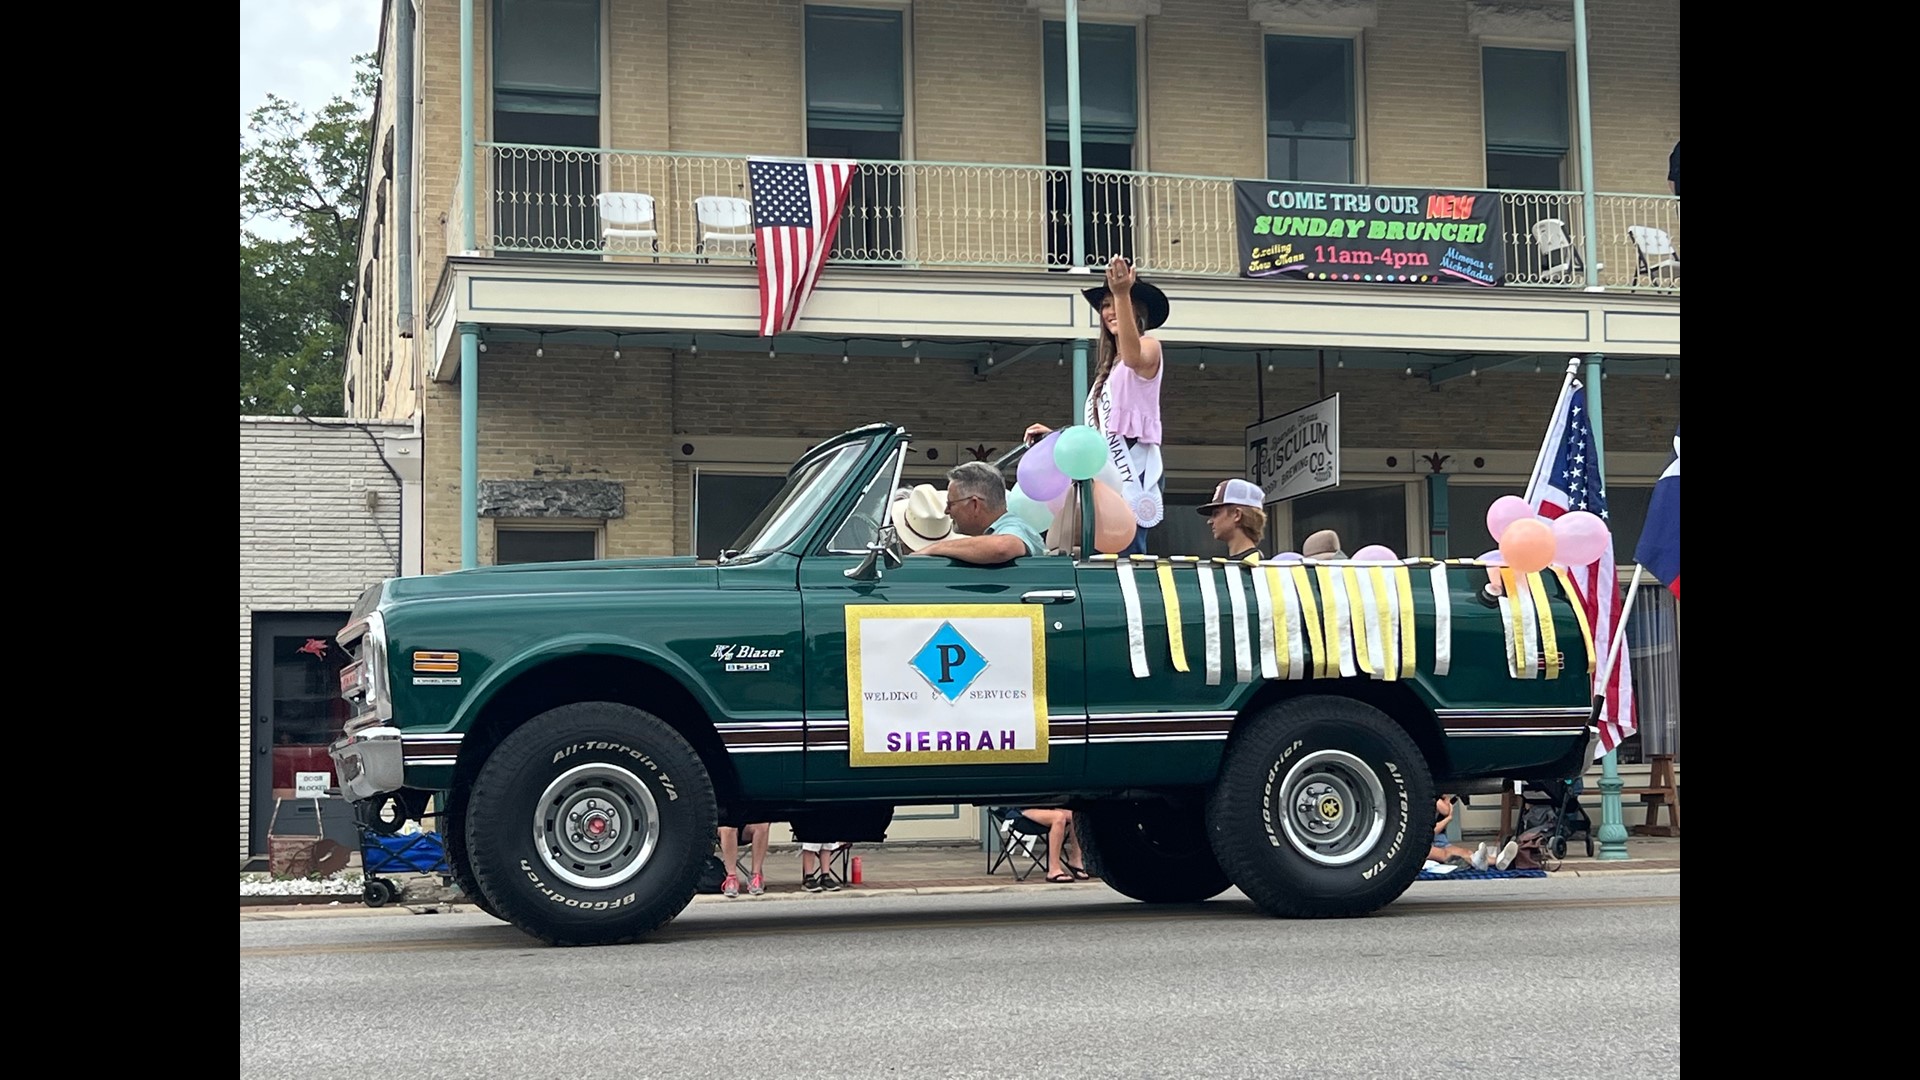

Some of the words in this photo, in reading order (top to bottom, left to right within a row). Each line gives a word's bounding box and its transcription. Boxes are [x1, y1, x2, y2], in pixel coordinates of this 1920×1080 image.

[1267, 190, 1327, 210] COME
[1330, 193, 1371, 213] TRY
[1375, 195, 1419, 215] OUR
[1426, 194, 1475, 220] NEW
[1253, 215, 1364, 238] SUNDAY
[1367, 220, 1487, 243] BRUNCH!
[1315, 245, 1429, 268] 11am-4pm
[1250, 422, 1332, 486] TUSCULUM
[736, 645, 784, 658] Blazer
[936, 644, 966, 683] P
[864, 692, 918, 701] WELDING
[969, 690, 1027, 699] SERVICES
[887, 730, 1016, 752] SIERRAH
[552, 741, 658, 771] All-Terrain
[658, 772, 679, 802] T/A
[1263, 740, 1303, 847] BFGoodrich
[1385, 762, 1409, 859] All-Terrain
[520, 859, 636, 911] BFGoodrich
[1362, 863, 1387, 880] T/A
